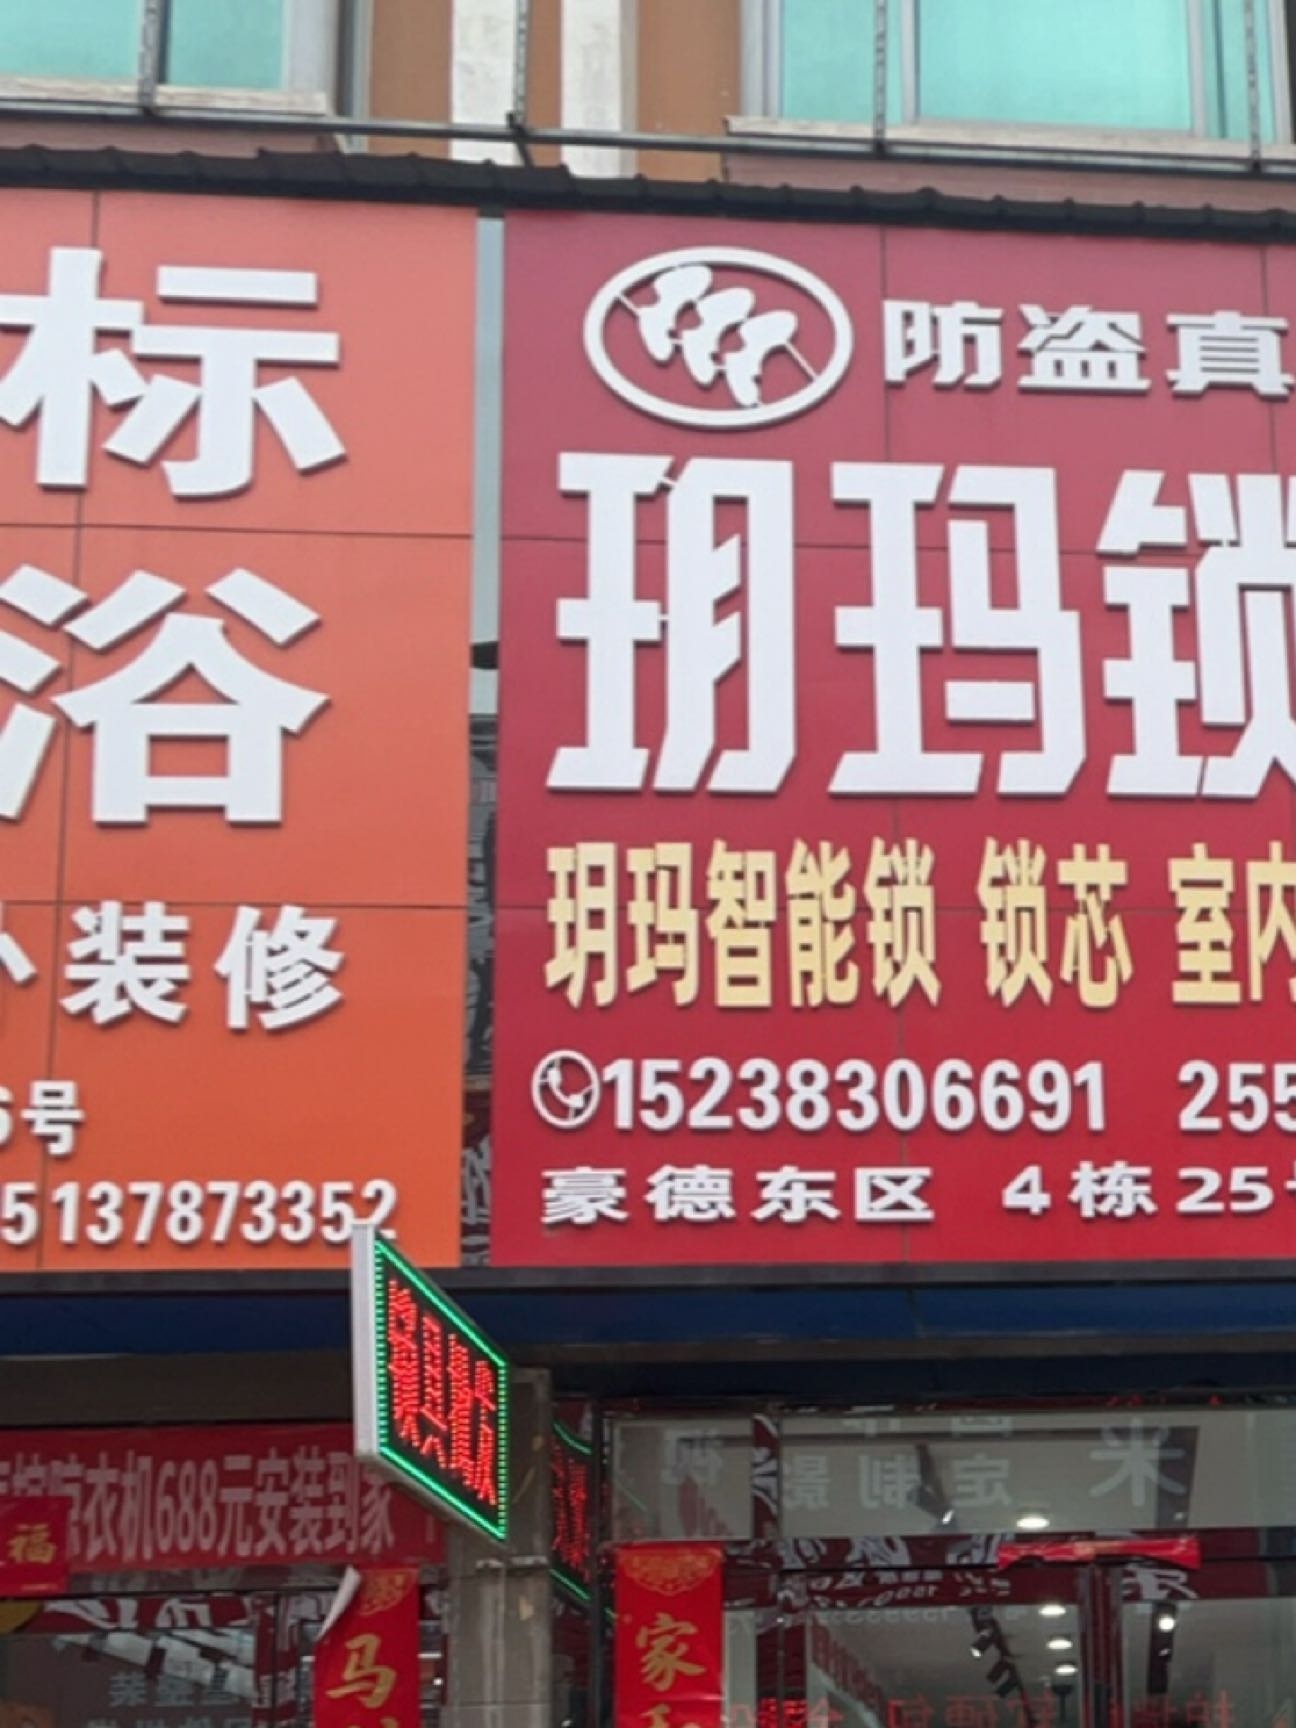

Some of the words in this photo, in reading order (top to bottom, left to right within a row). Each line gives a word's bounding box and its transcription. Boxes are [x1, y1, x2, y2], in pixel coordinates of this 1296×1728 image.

[0, 246, 346, 500] 标
[0, 564, 330, 824] 浴
[0, 900, 344, 1031] 装修
[545, 838, 942, 1009] 玥玛智能锁
[977, 837, 1134, 1008] 锁芯
[602, 1056, 1106, 1132] 15238306691
[0, 1179, 398, 1245] 5137873352
[541, 1164, 936, 1225] 豪德东区
